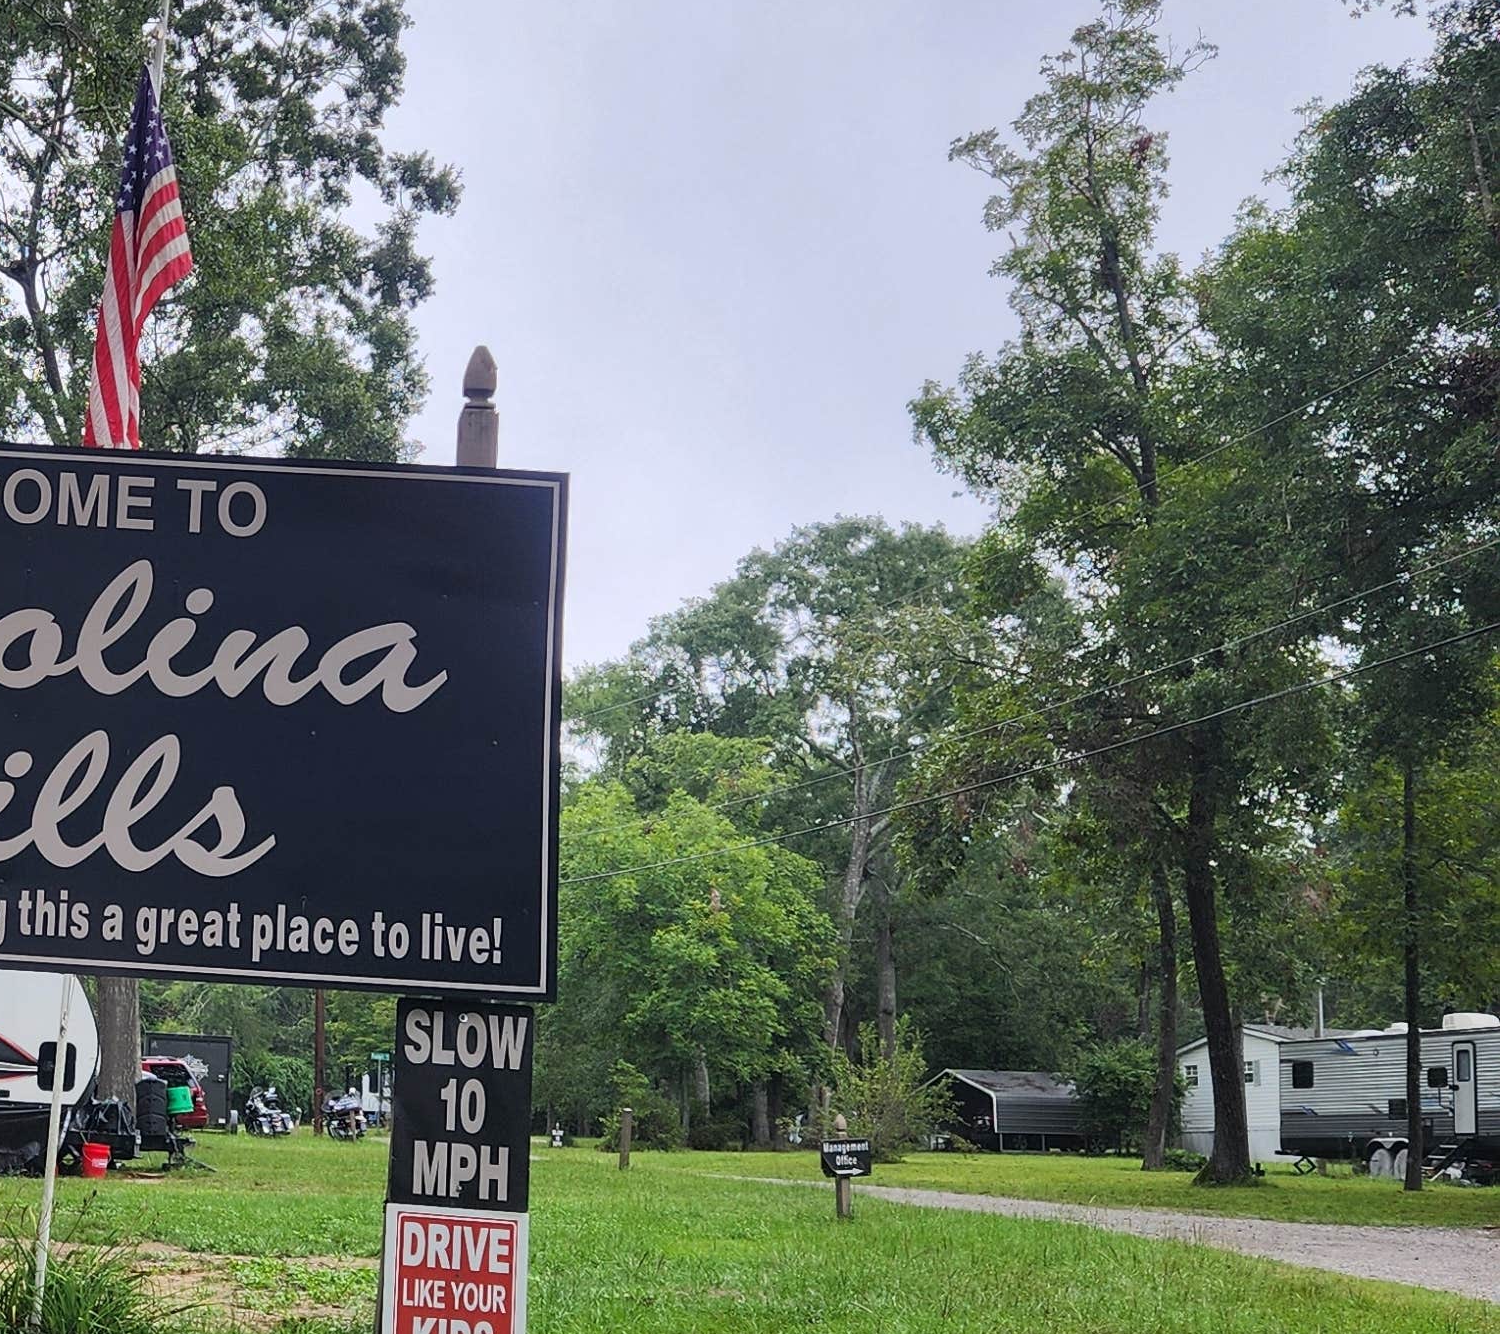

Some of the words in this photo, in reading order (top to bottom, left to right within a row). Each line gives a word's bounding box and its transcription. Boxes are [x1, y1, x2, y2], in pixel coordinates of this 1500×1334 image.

[176, 479, 268, 537] TO
[18, 889, 90, 940] this
[102, 904, 124, 941] a
[135, 906, 242, 955] great
[251, 903, 360, 963] place
[371, 911, 410, 959] to
[421, 913, 503, 964] live!
[404, 1010, 528, 1071] SLOW
[440, 1078, 486, 1134] 10
[412, 1140, 509, 1202] MPH
[823, 1141, 868, 1154] Management
[836, 1155, 857, 1166] Office
[402, 1221, 511, 1274] DRIVE
[402, 1277, 446, 1309] LIKE
[450, 1281, 507, 1315] YOUR
